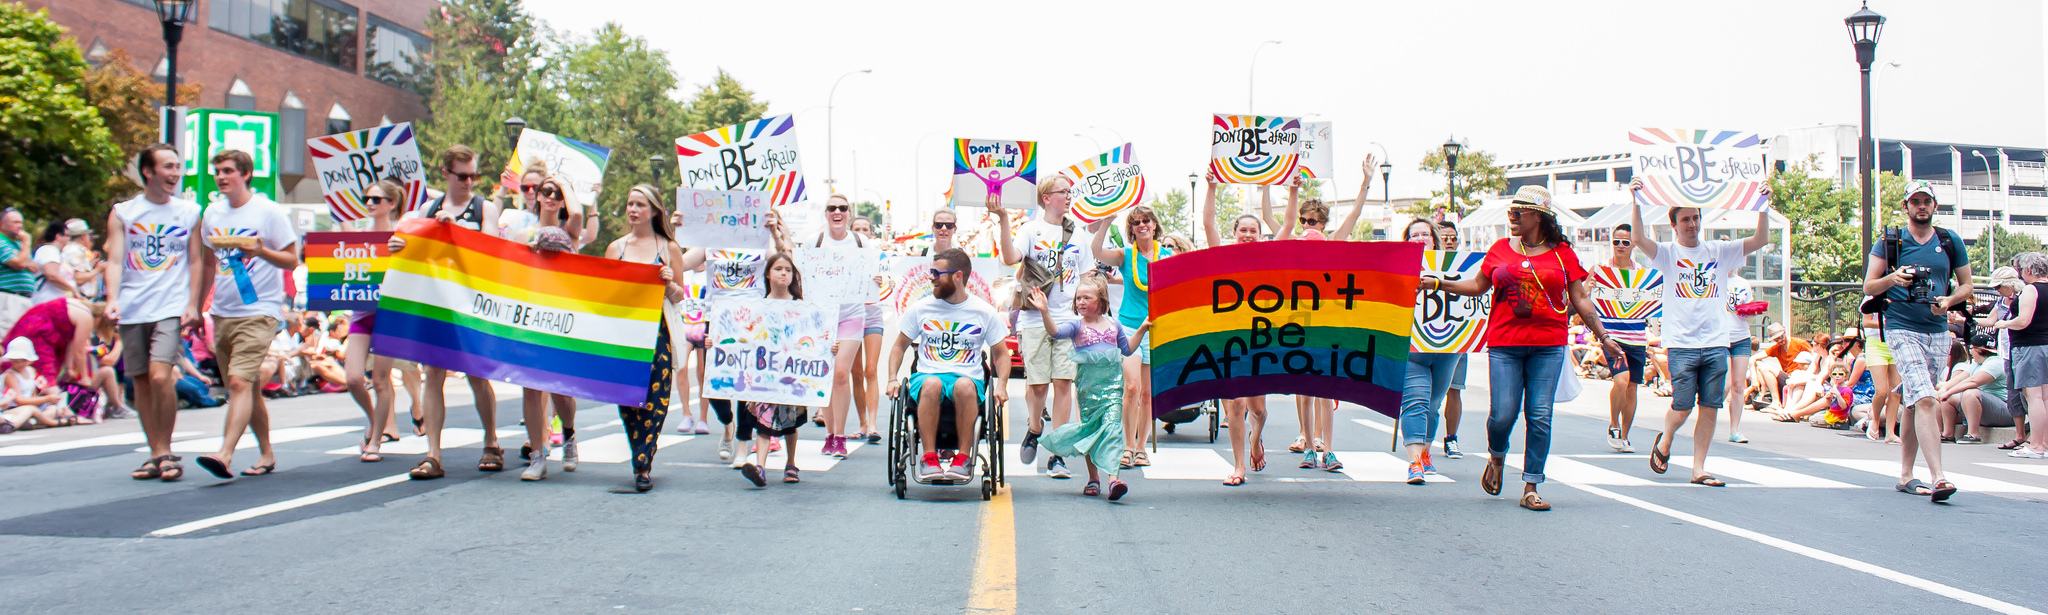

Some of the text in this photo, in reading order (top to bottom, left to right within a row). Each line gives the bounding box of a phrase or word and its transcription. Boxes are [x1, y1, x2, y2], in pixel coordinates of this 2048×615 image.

[969, 142, 1019, 156] Don't Be
[1238, 128, 1270, 157] BE
[348, 148, 384, 191] BE
[720, 141, 764, 191] BE
[977, 154, 1015, 169] Afraid
[1676, 146, 1723, 183] BE
[1086, 169, 1117, 195] BE
[744, 195, 761, 208] Be
[146, 234, 166, 257] BE
[333, 241, 379, 260] don't
[726, 261, 744, 278] BE
[1048, 249, 1058, 268] B
[343, 263, 372, 281] BE
[1693, 268, 1709, 287] BE
[1212, 272, 1365, 314] Don't
[1728, 292, 1741, 306] BE
[512, 304, 532, 326] BE
[531, 311, 575, 334] AFRAID
[941, 331, 960, 350] BE
[1250, 316, 1306, 350] Be
[756, 345, 780, 372] BE
[784, 356, 829, 377] AFRAID
[1177, 335, 1376, 386] Afraid
